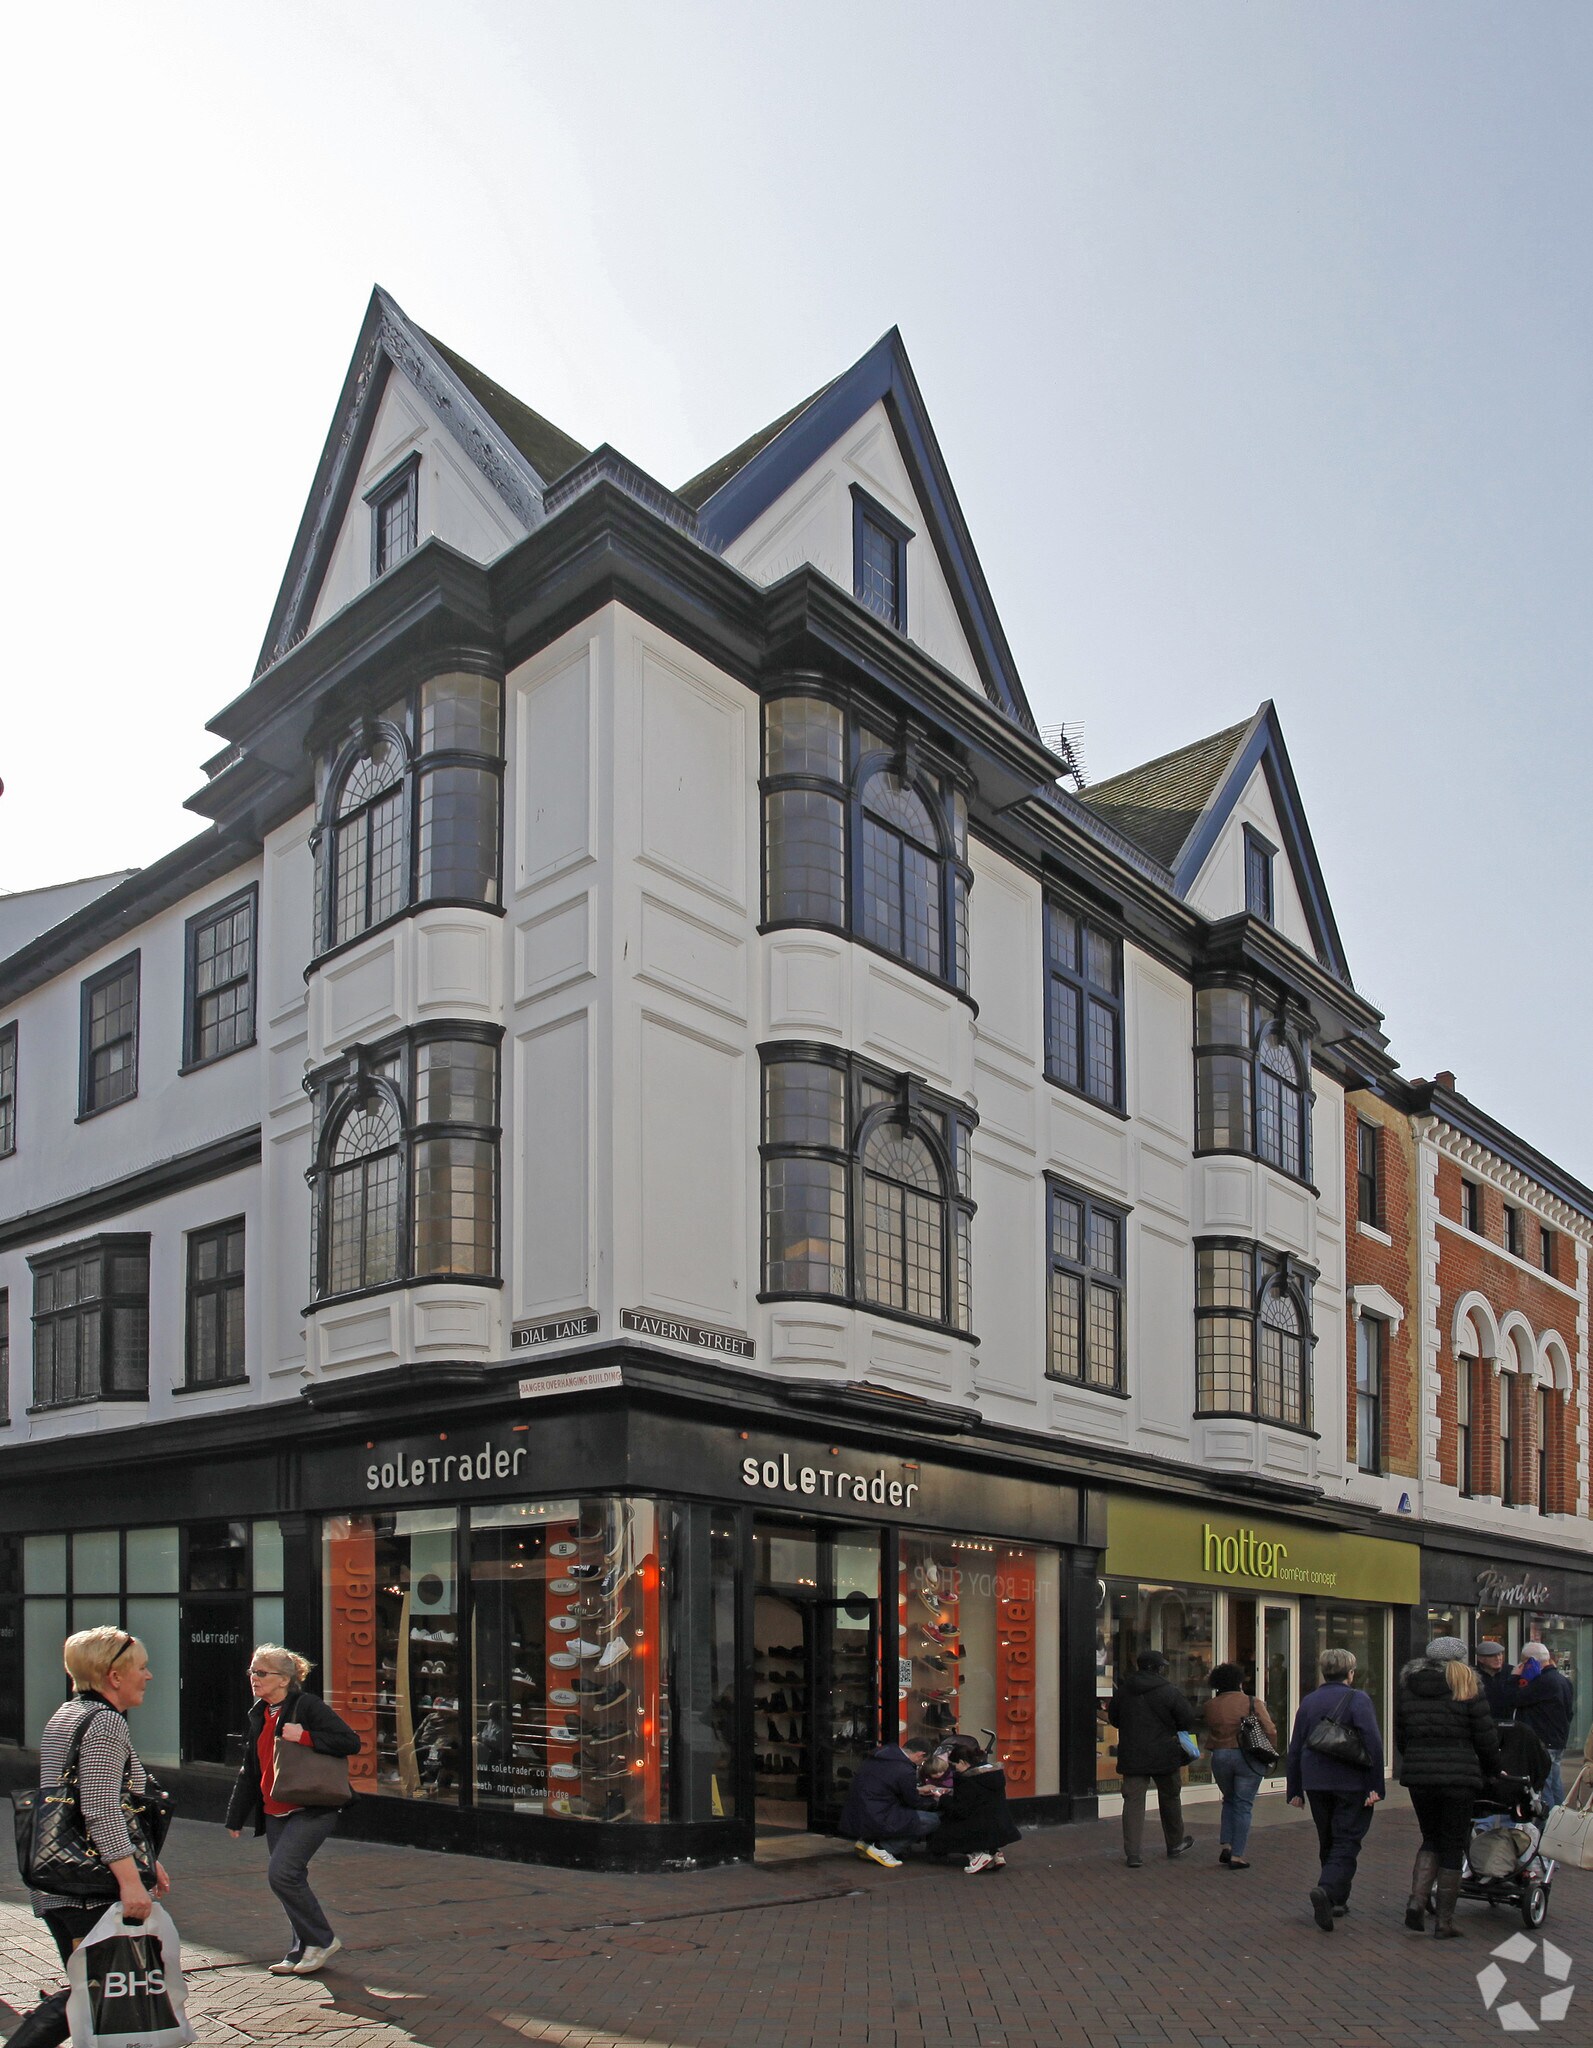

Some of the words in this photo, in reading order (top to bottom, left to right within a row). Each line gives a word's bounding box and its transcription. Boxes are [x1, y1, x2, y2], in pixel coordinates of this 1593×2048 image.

[520, 1330, 548, 1346] DIAL
[555, 1319, 588, 1339] LANE
[631, 1314, 690, 1341] TAVERN
[698, 1331, 747, 1355] STREET
[521, 1381, 546, 1394] DANGER
[545, 1376, 588, 1390] OVERHANGING
[588, 1371, 621, 1384] BUILDING
[1204, 1523, 1288, 1578] hotter
[1280, 1567, 1309, 1583] comfort
[1310, 1571, 1337, 1588] concept
[475, 1763, 558, 1778] www.soletrader.co.u
[497, 1783, 526, 1795] norwich
[530, 1788, 569, 1799] cambridge
[104, 1969, 167, 1998] BHS
